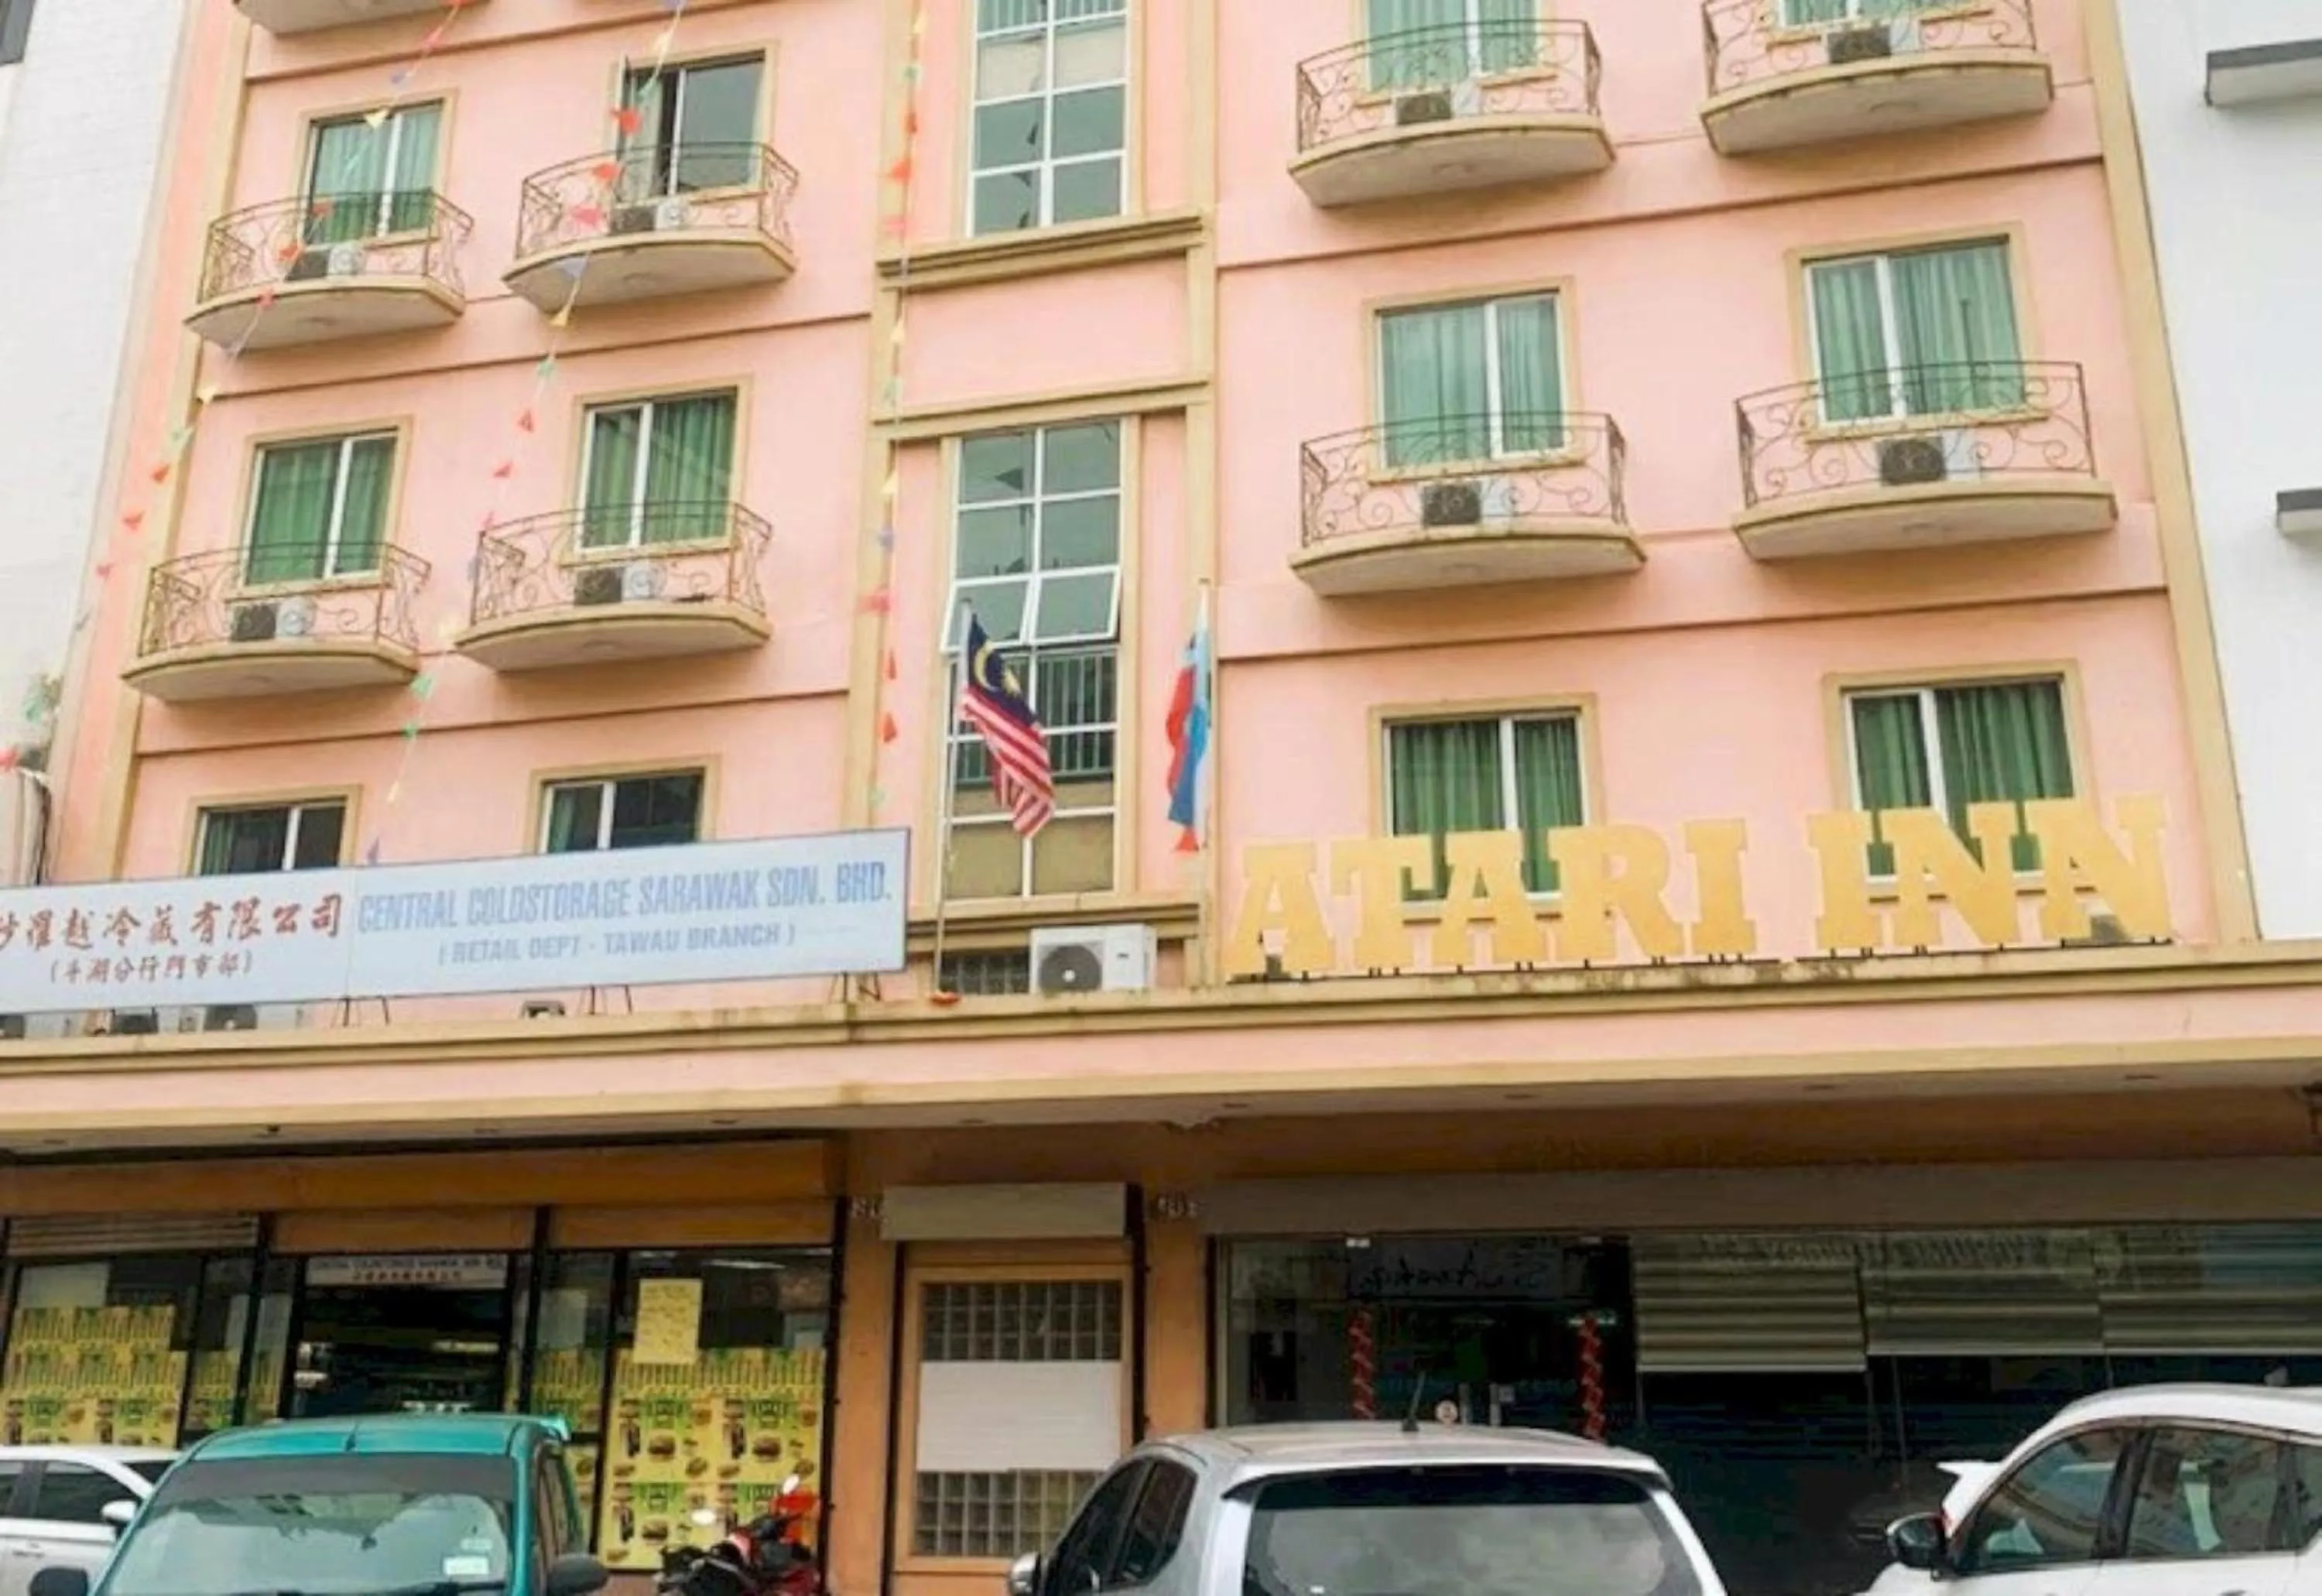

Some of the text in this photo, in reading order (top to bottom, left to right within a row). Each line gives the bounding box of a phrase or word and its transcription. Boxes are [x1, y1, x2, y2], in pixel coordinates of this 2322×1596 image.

[358, 861, 892, 933] CENTRAL COLDSTORAGE SARAWAK SDN. BHD.
[1221, 794, 2173, 980] ATARI INN
[452, 937, 522, 964] RETAIL
[529, 933, 581, 961] DEPT
[604, 929, 681, 956] TAWAU
[687, 923, 782, 951] BRANCH
